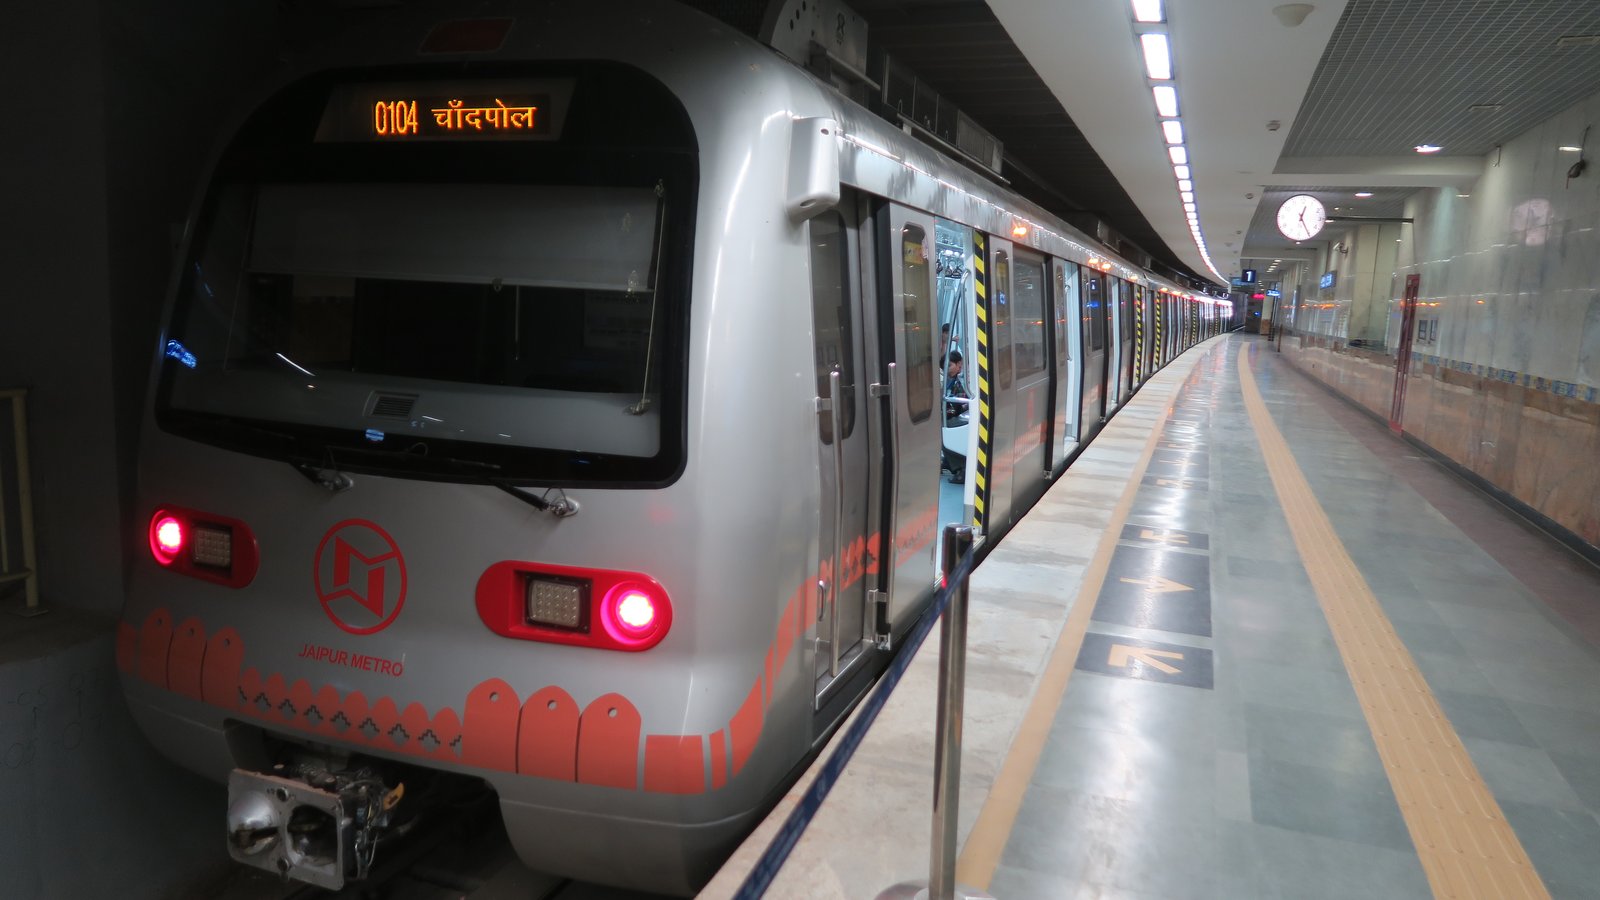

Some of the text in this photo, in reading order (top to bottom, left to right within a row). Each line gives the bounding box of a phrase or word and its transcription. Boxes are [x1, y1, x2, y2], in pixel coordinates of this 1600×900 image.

[375, 98, 537, 134] 0104 चाँदपोल
[1245, 271, 1252, 282] 1
[299, 644, 403, 677] JAIPUR METRO
